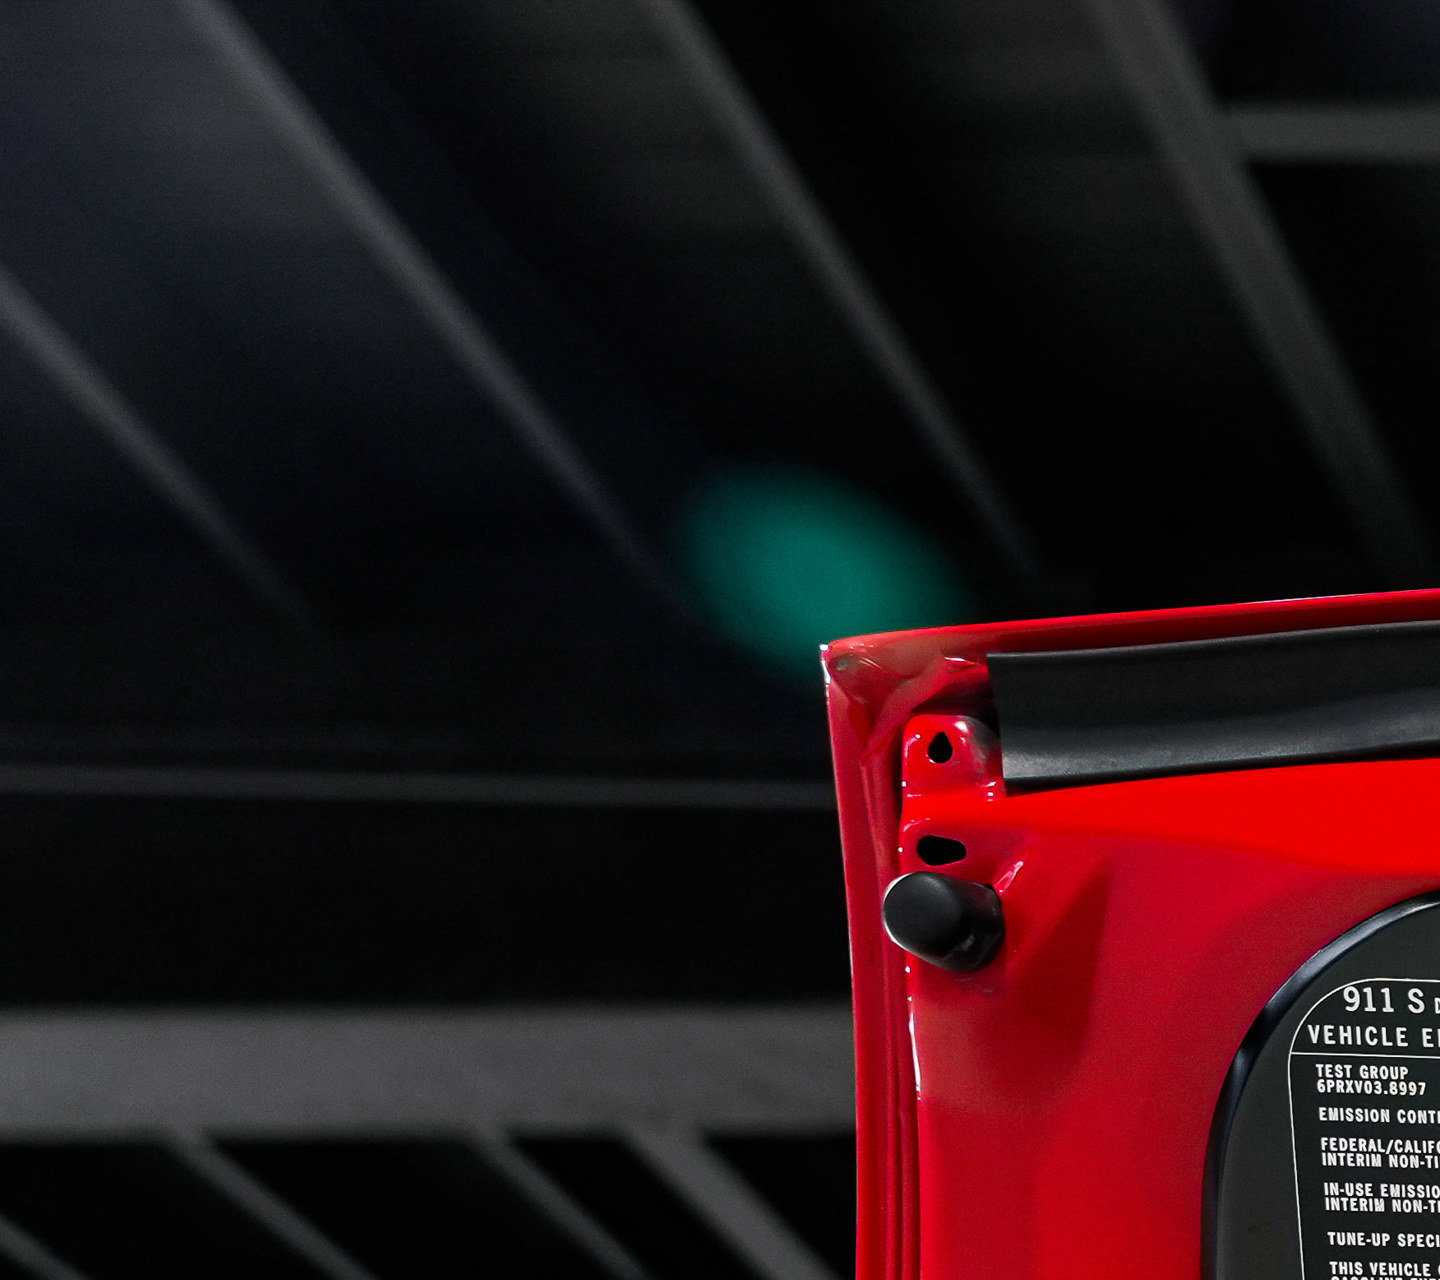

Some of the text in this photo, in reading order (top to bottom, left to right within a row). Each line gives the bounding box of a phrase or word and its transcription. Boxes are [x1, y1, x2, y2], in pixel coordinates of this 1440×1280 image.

[1343, 986, 1394, 1012] 911
[1408, 988, 1425, 1013] S
[1307, 1024, 1408, 1047] VEHICLE
[1315, 1064, 1408, 1080] TEST GROUP
[1317, 1079, 1426, 1096] 6PRXV03.8997
[1319, 1107, 1390, 1123] EMISSION
[1324, 1182, 1373, 1196] IN-USE
[1327, 1232, 1390, 1246] TUNE-UP
[1329, 1261, 1363, 1275] THIS
[1369, 1262, 1431, 1277] VEHICLE
